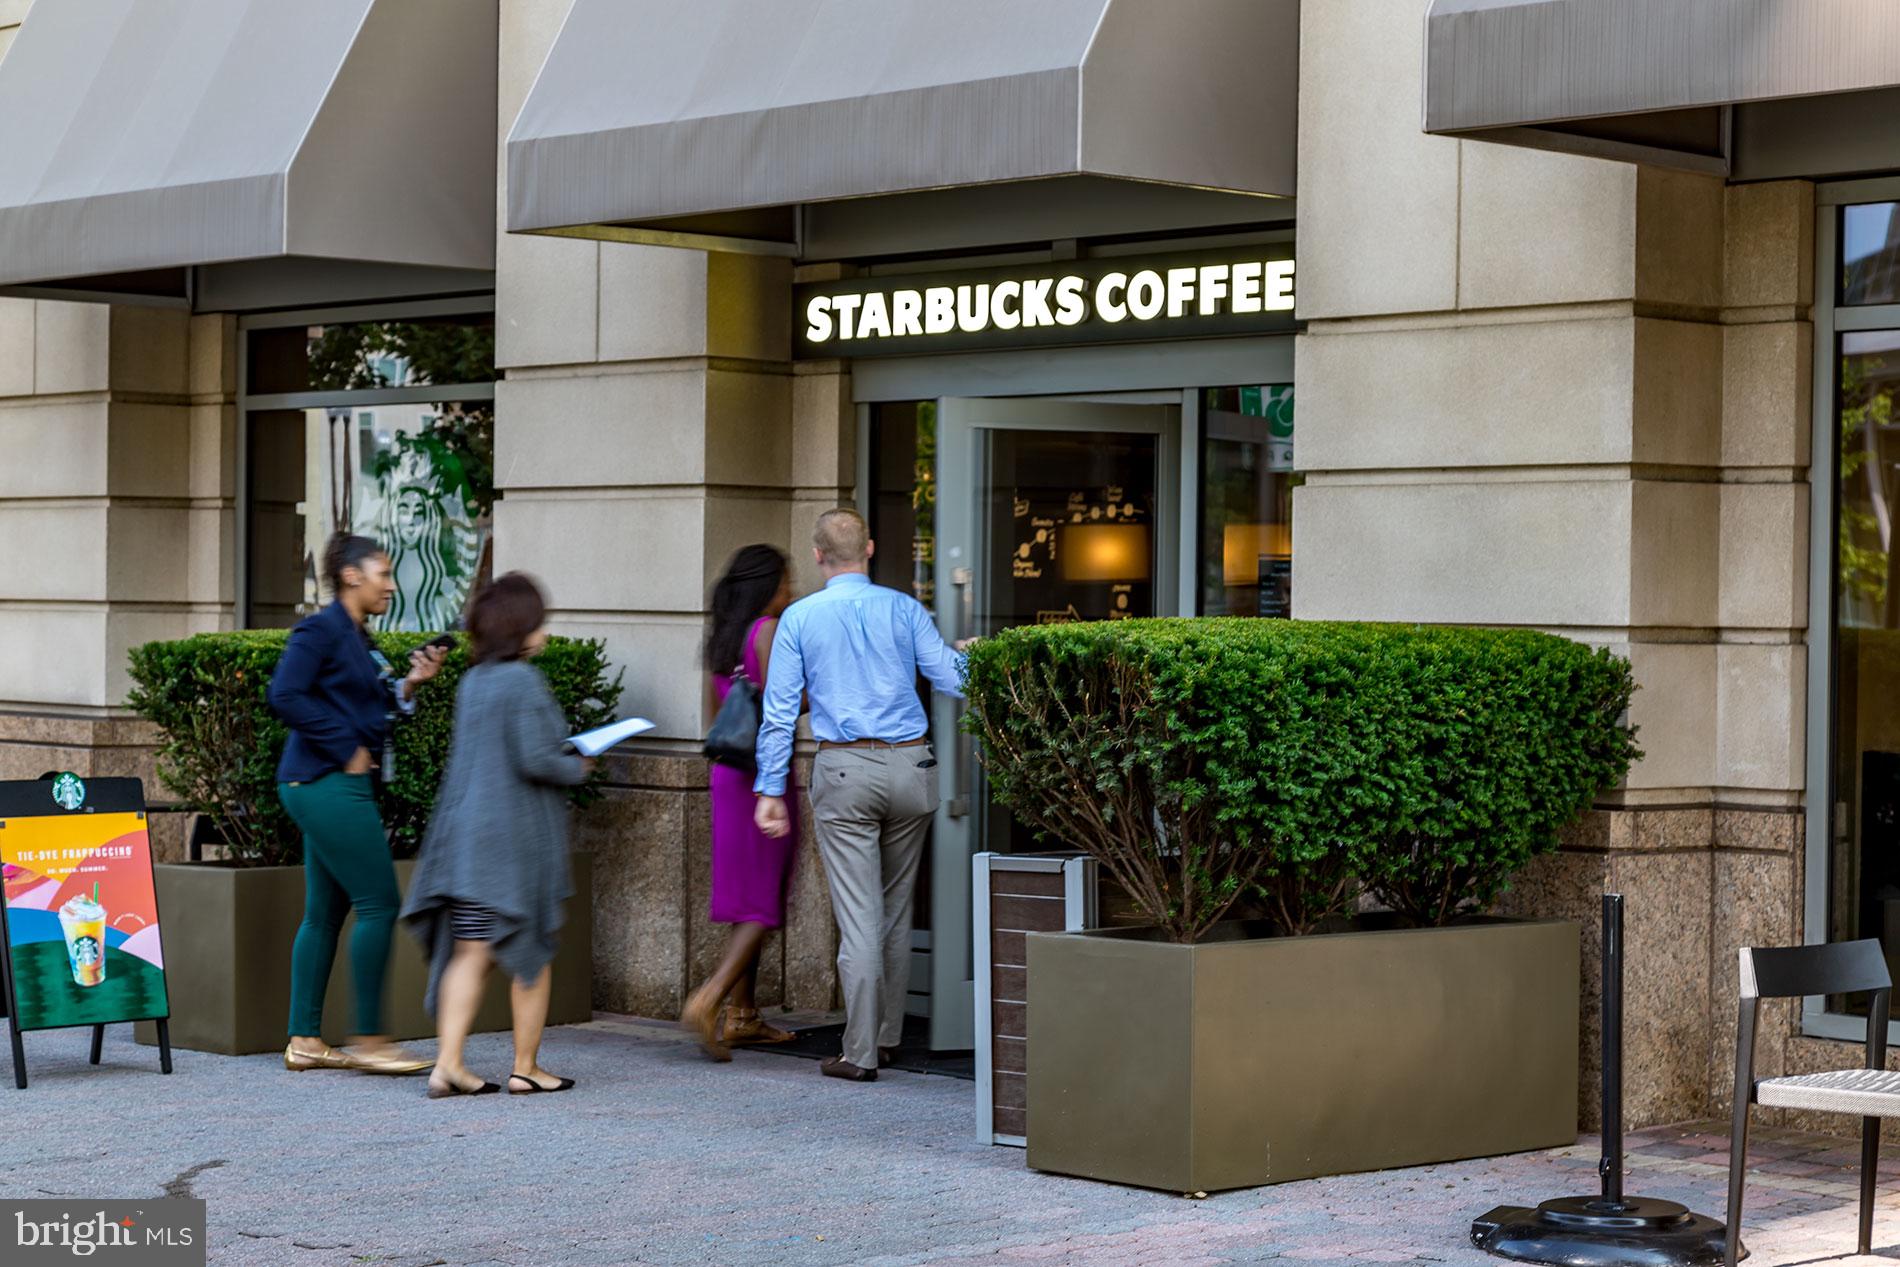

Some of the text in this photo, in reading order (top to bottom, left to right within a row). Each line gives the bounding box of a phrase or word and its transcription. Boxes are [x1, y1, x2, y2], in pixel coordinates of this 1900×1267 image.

[806, 259, 1295, 342] STARBUCKS COFFEE
[17, 850, 58, 861] TIE-DYE
